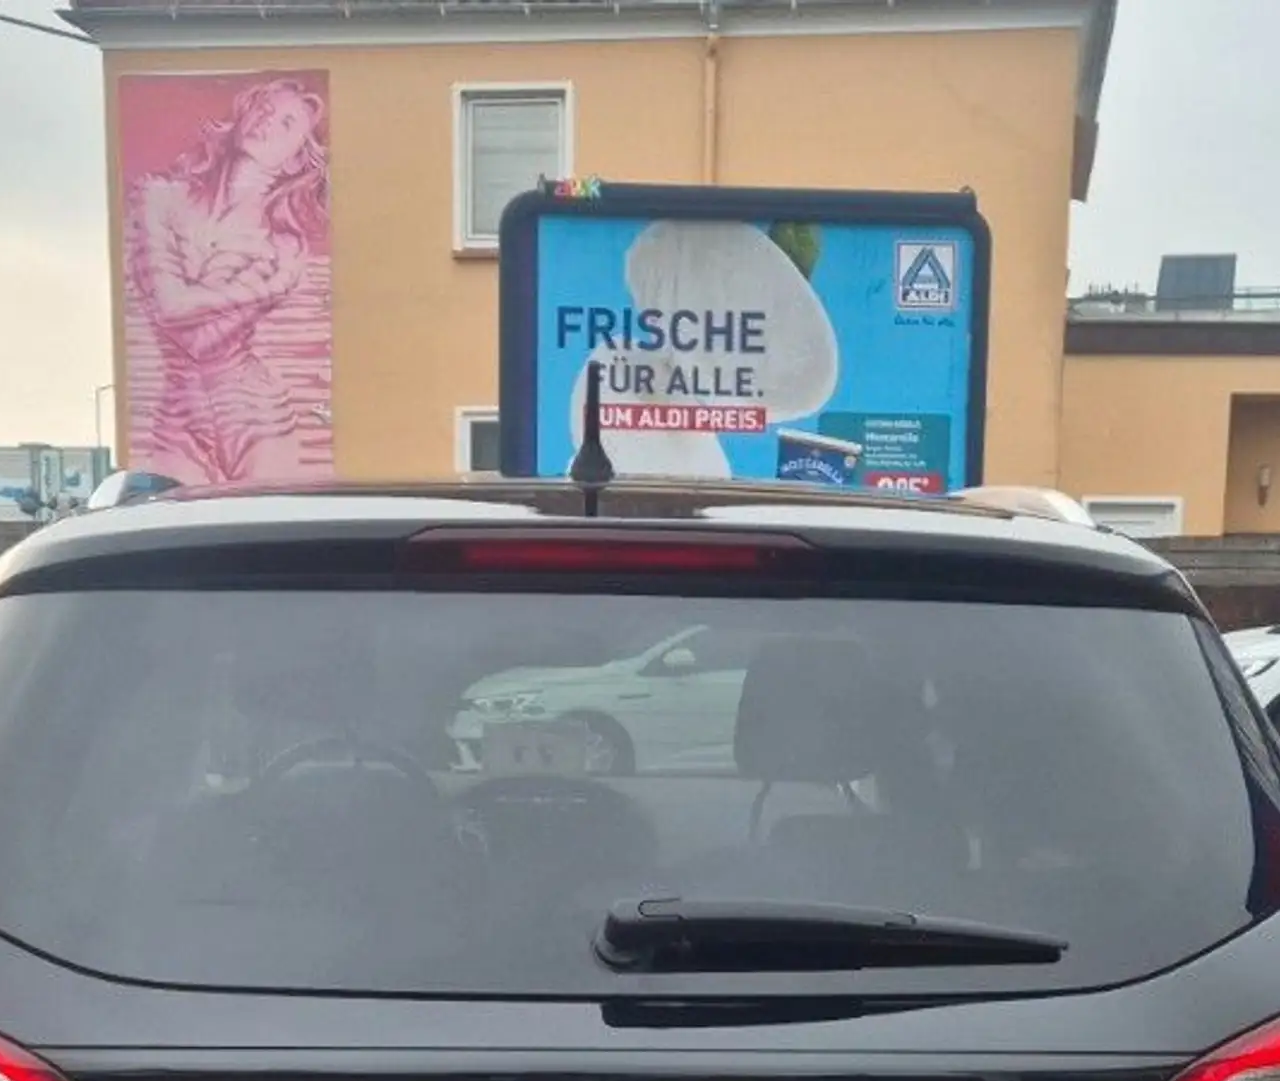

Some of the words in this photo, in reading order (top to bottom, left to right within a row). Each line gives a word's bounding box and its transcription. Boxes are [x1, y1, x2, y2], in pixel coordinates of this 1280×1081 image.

[556, 306, 766, 353] FRISCHE
[666, 365, 764, 398] ALLE.
[599, 406, 633, 427] UM
[638, 408, 690, 428] ALDI
[695, 410, 763, 430] PREIS.
